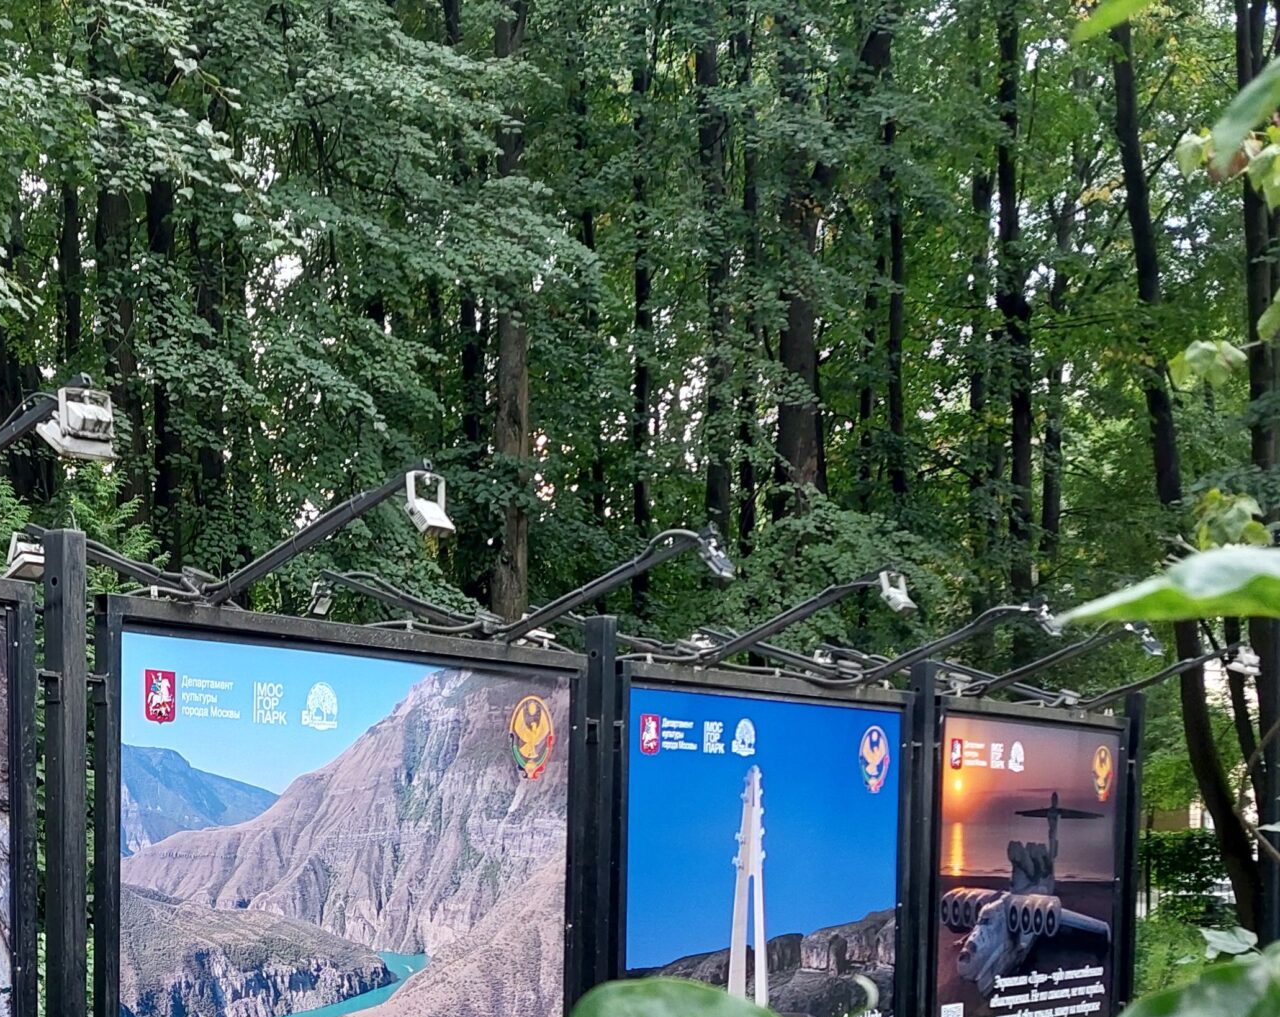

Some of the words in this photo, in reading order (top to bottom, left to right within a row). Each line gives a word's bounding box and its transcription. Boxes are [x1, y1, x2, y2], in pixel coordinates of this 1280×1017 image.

[181, 675, 234, 691] Департамент
[257, 682, 284, 698] МОС
[181, 692, 218, 705] культуры
[257, 697, 280, 710] ГОР
[210, 707, 241, 720] Москвы
[257, 710, 288, 725] ПАРК
